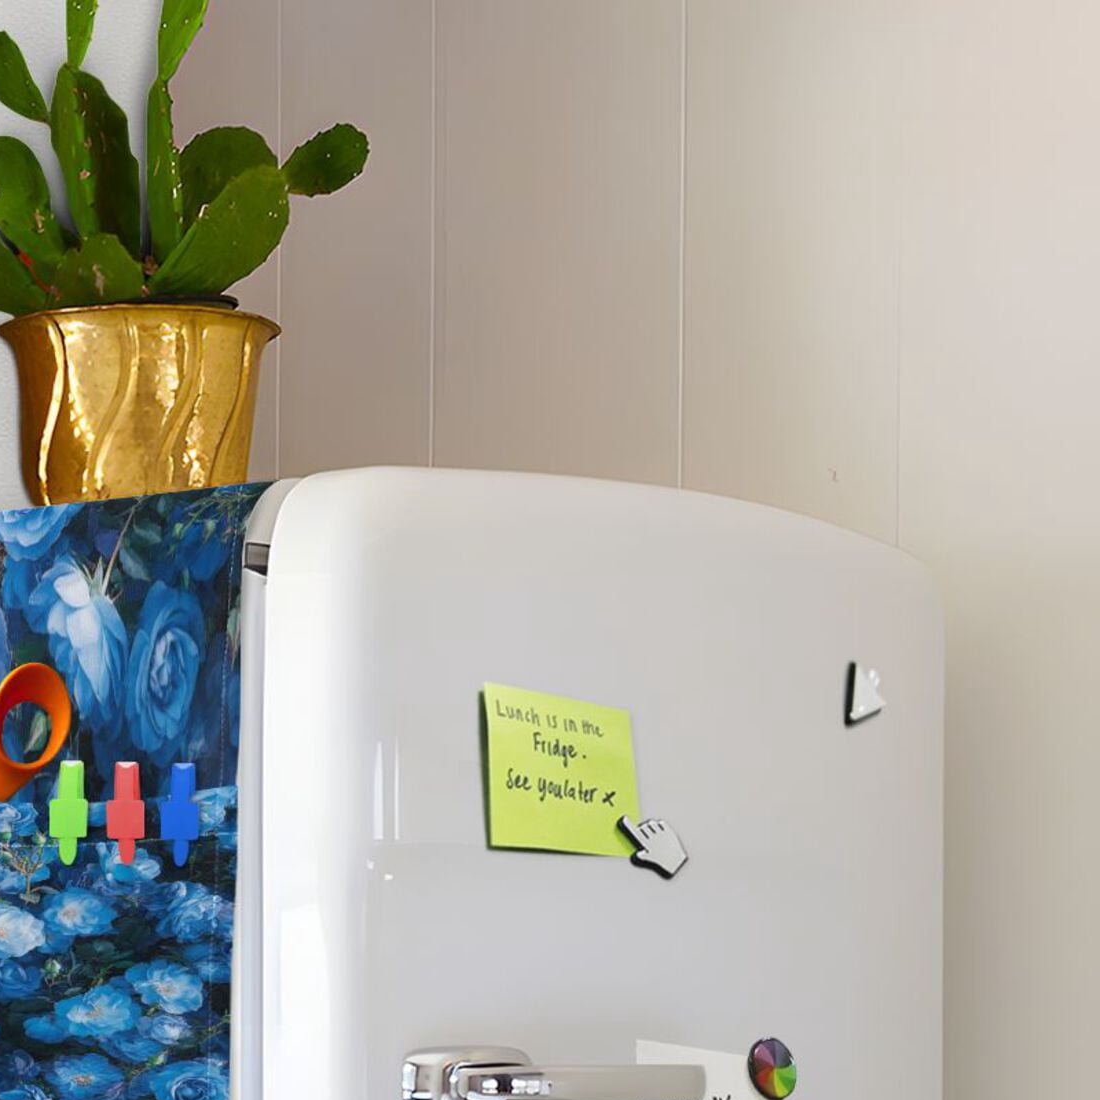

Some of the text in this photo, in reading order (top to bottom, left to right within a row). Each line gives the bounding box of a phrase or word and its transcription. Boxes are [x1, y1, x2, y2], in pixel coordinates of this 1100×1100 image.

[496, 699, 604, 738] Lunch is in the
[506, 768, 532, 791] See
